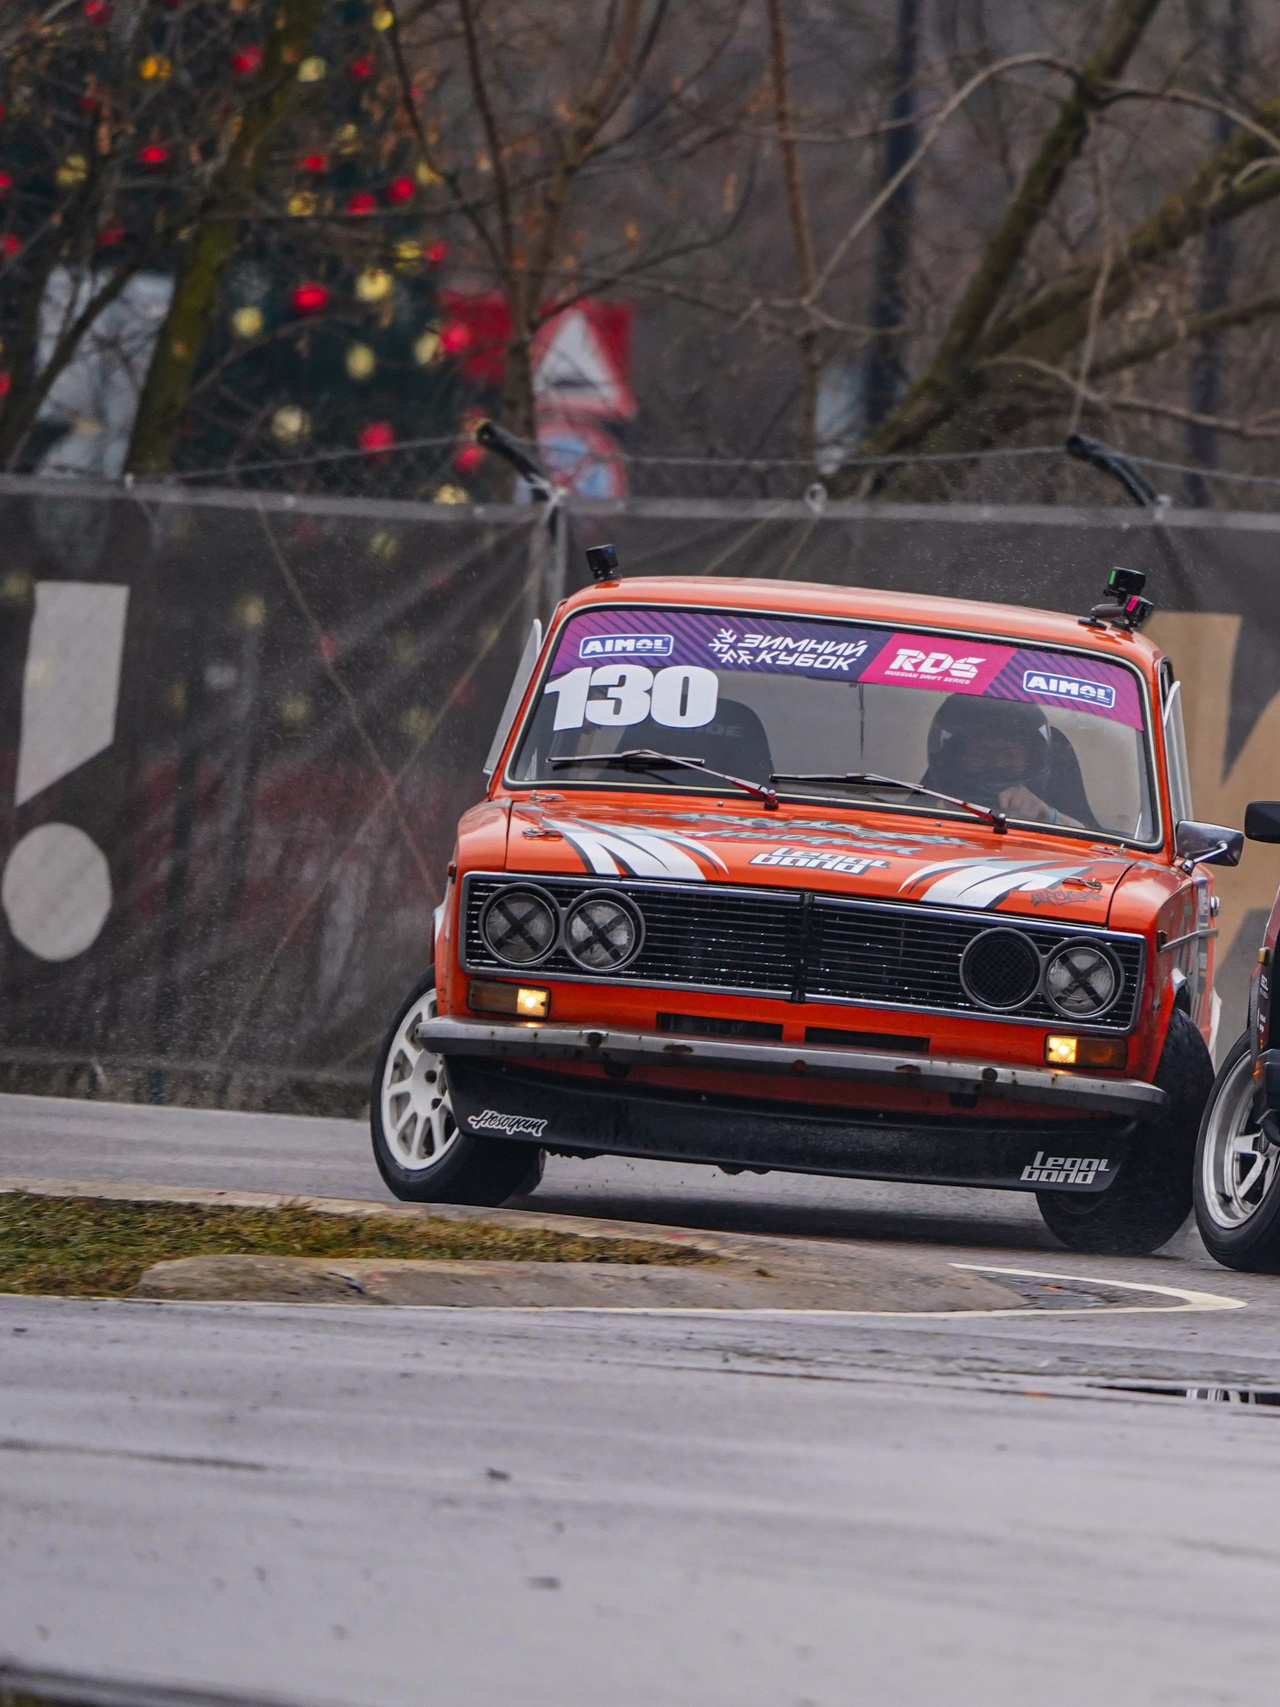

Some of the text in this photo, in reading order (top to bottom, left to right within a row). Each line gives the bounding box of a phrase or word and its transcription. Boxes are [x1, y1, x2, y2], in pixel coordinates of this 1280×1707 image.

[583, 638, 668, 655] AIMOL
[737, 634, 868, 657] ЗИМНИЙ
[755, 650, 857, 671] КУБОК
[888, 648, 987, 679] RDS
[884, 670, 918, 679] RUSSIAN
[943, 677, 971, 685] SERIES
[1027, 676, 1111, 704] AIMOL
[544, 664, 719, 731] 130
[468, 1110, 548, 1137] Hesoyam
